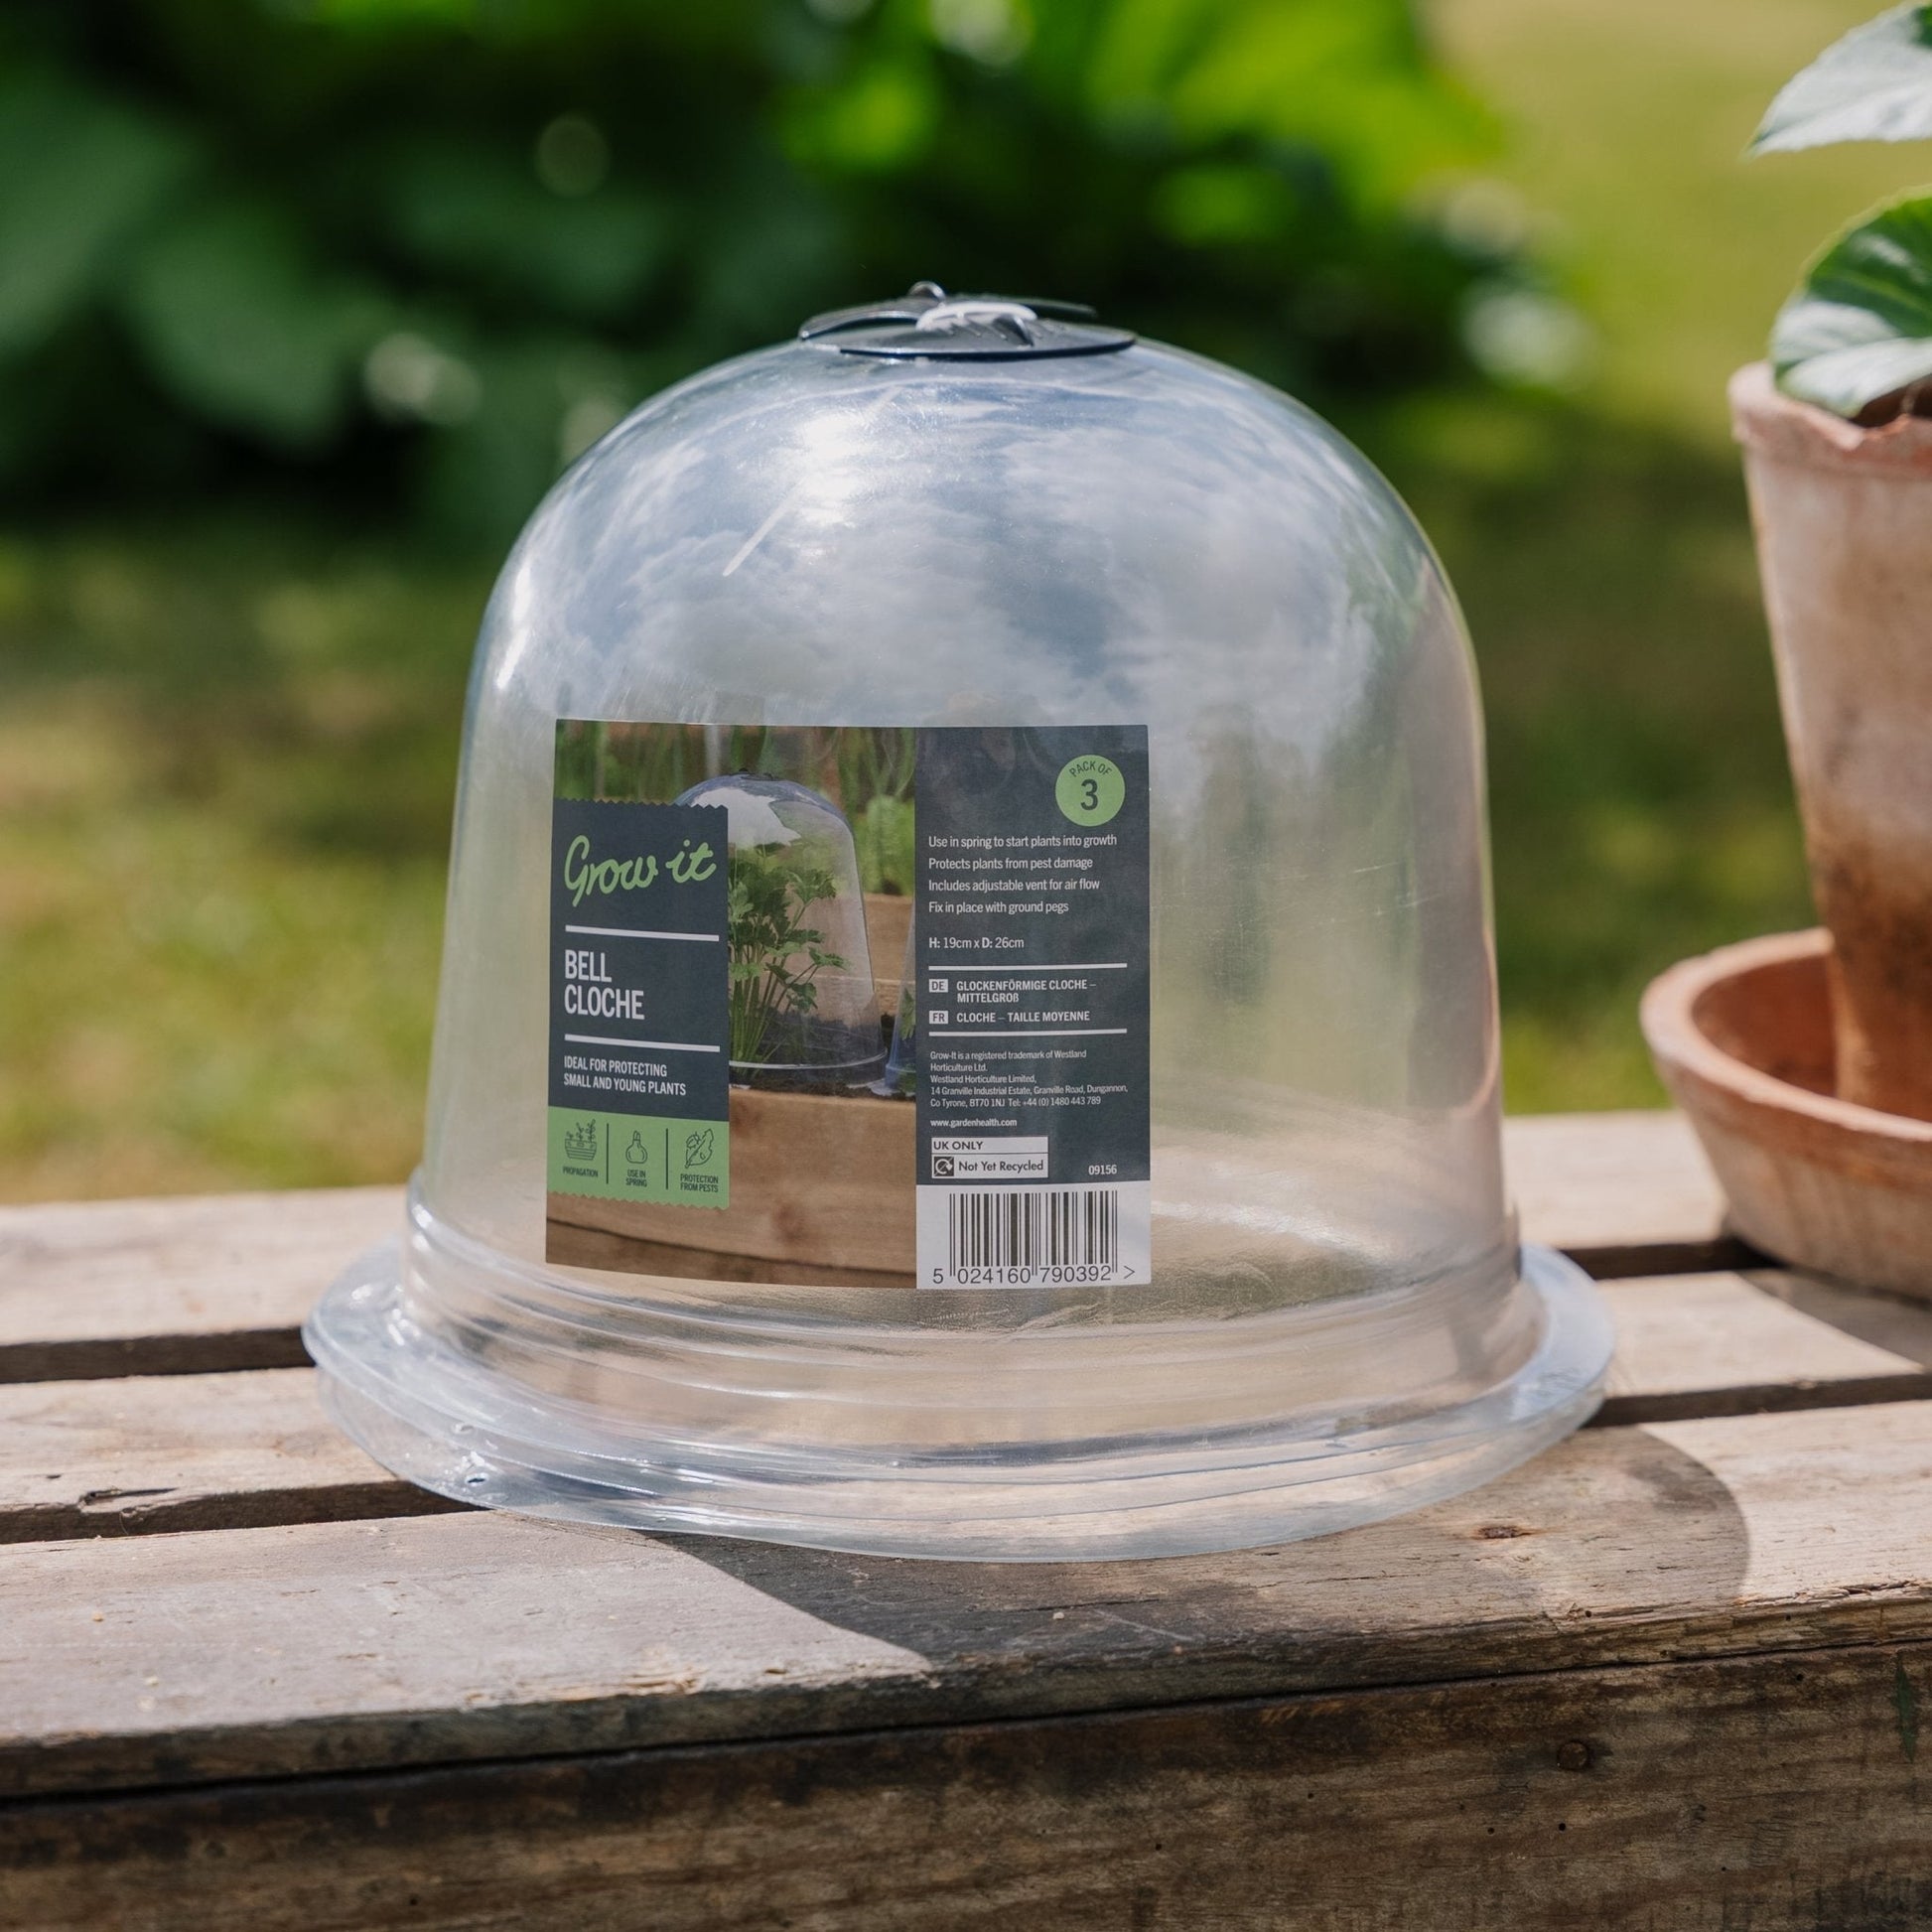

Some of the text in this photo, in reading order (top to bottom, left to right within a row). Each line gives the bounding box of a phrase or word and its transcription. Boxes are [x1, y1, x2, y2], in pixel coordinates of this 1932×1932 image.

[1069, 760, 1113, 777] PACK OF
[1080, 778, 1098, 811] 3
[928, 834, 1117, 849] Use in spring to start plants into growth
[928, 857, 1093, 871] Protects plants from pest damage
[564, 835, 717, 907] Grow it
[928, 879, 1100, 893] Includes adjustable vent for air flow
[928, 901, 1069, 914] Fix in place with ground pegs
[929, 937, 940, 948] H:
[943, 937, 972, 948] 19cm
[982, 937, 993, 948] D:
[995, 937, 1024, 947] 26cm
[565, 949, 612, 982] BELL
[931, 981, 945, 991] DE
[957, 979, 1046, 991] GLOCKENFÖRMIGE
[1048, 979, 1087, 990] CLOCHE
[565, 984, 645, 1020] CLOCHE
[933, 1012, 945, 1023] FR
[957, 1013, 996, 1023] CLOCHE
[1008, 1012, 1039, 1023] TAILLE
[1042, 1012, 1090, 1022] MOYENNE
[971, 1050, 1007, 1061] registered
[1009, 1050, 1044, 1059] trademark
[1045, 1049, 1053, 1059] of
[1054, 1049, 1086, 1058] Westland
[564, 1055, 667, 1077] IDEAL FOR PROTECTING
[564, 1073, 686, 1096] SMALL AND YOUNG PLANTS
[965, 1074, 1007, 1083] Horticulture
[1008, 1074, 1036, 1083] Limited,
[942, 1086, 972, 1095] Granville
[974, 1086, 1007, 1095] Industrial
[1008, 1086, 1033, 1095] Estate,
[1034, 1085, 1064, 1095] Granville
[1065, 1085, 1085, 1094] Road,
[1087, 1084, 1128, 1094] Dungannon,
[942, 1098, 968, 1109] Tyrone,
[970, 1098, 989, 1107] BT70
[992, 1098, 1005, 1107] 1NJ
[1008, 1098, 1021, 1107] Tel:
[1023, 1097, 1036, 1106] +44
[1038, 1097, 1048, 1106] (0)
[1051, 1097, 1069, 1106] 1480
[1071, 1096, 1085, 1105] 443
[1086, 1096, 1101, 1105] 789
[930, 1118, 1017, 1128] www.gardenhealth.com
[952, 1141, 984, 1150] ONLY
[563, 1166, 599, 1177] PROPAGATION
[958, 1160, 1043, 1173] Not Yet Recycled
[1088, 1165, 1117, 1175] 09156
[625, 1177, 647, 1187] SPRING
[680, 1173, 719, 1184] PROTECTION
[699, 1183, 719, 1192] PESTS
[933, 1269, 943, 1284] 5
[957, 1268, 1031, 1284] 024160
[1039, 1266, 1111, 1283] 790392
